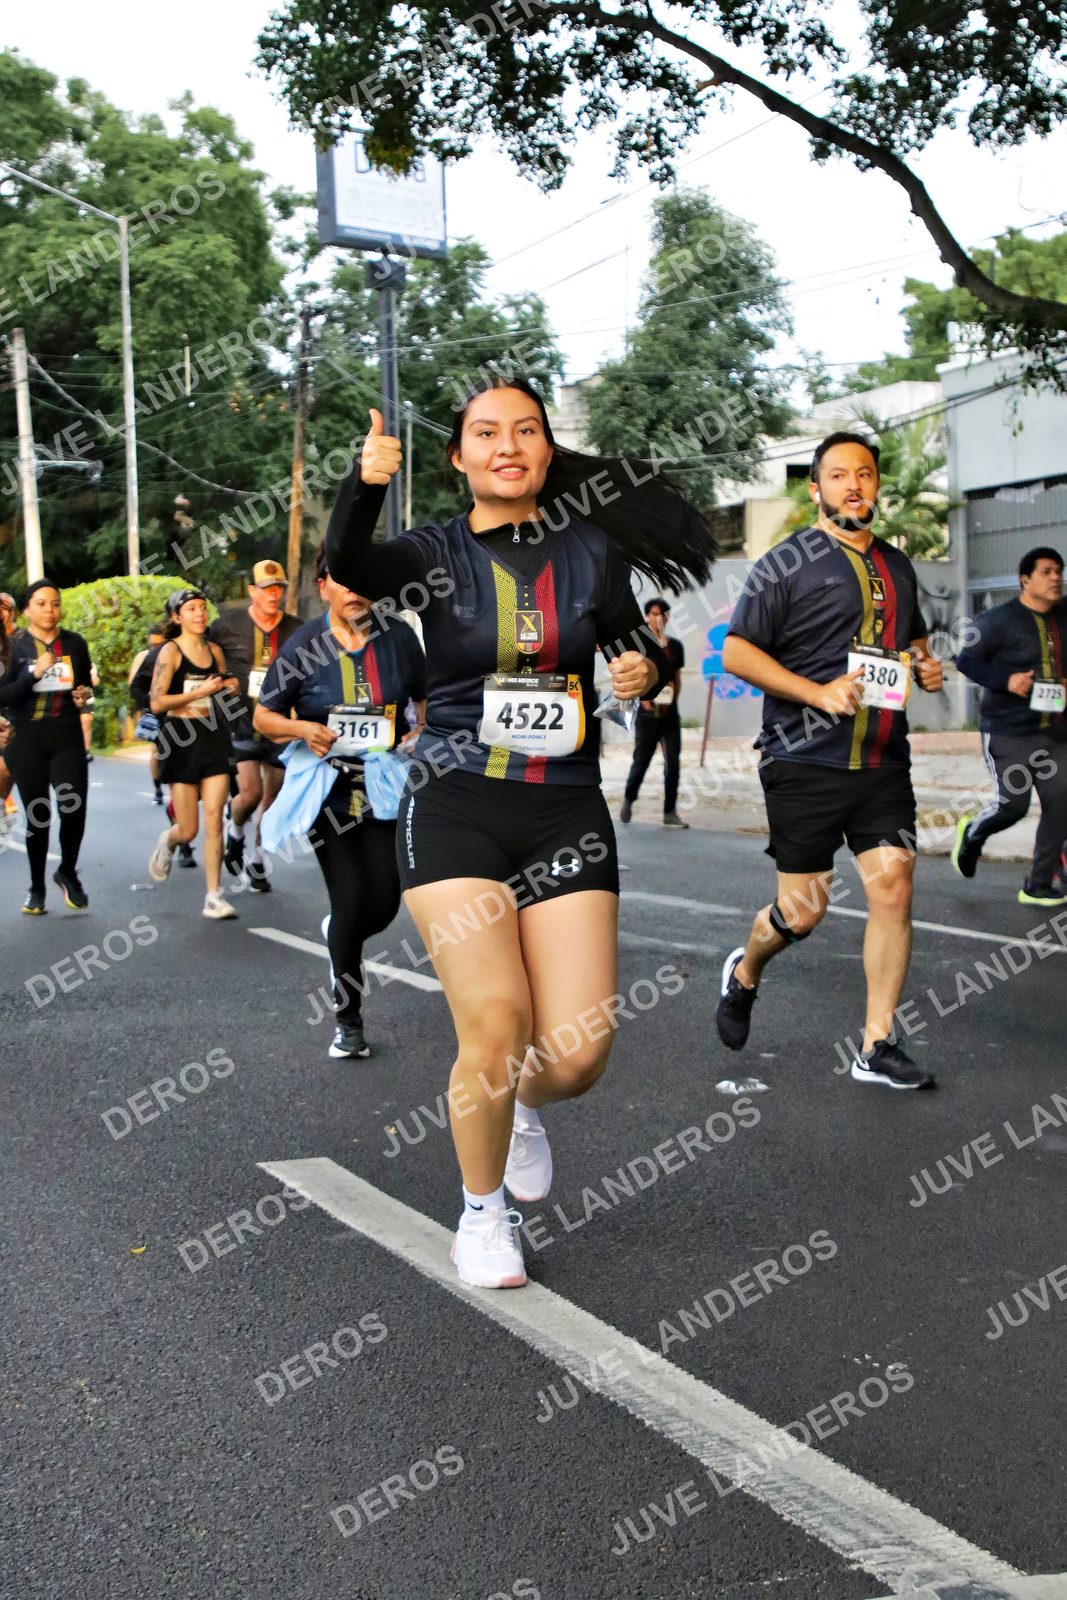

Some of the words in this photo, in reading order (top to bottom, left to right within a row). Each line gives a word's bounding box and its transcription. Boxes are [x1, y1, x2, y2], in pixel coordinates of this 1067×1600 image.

[338, 720, 379, 739] 3161
[496, 702, 564, 730] 4522
[406, 795, 416, 869] ARMOUR
